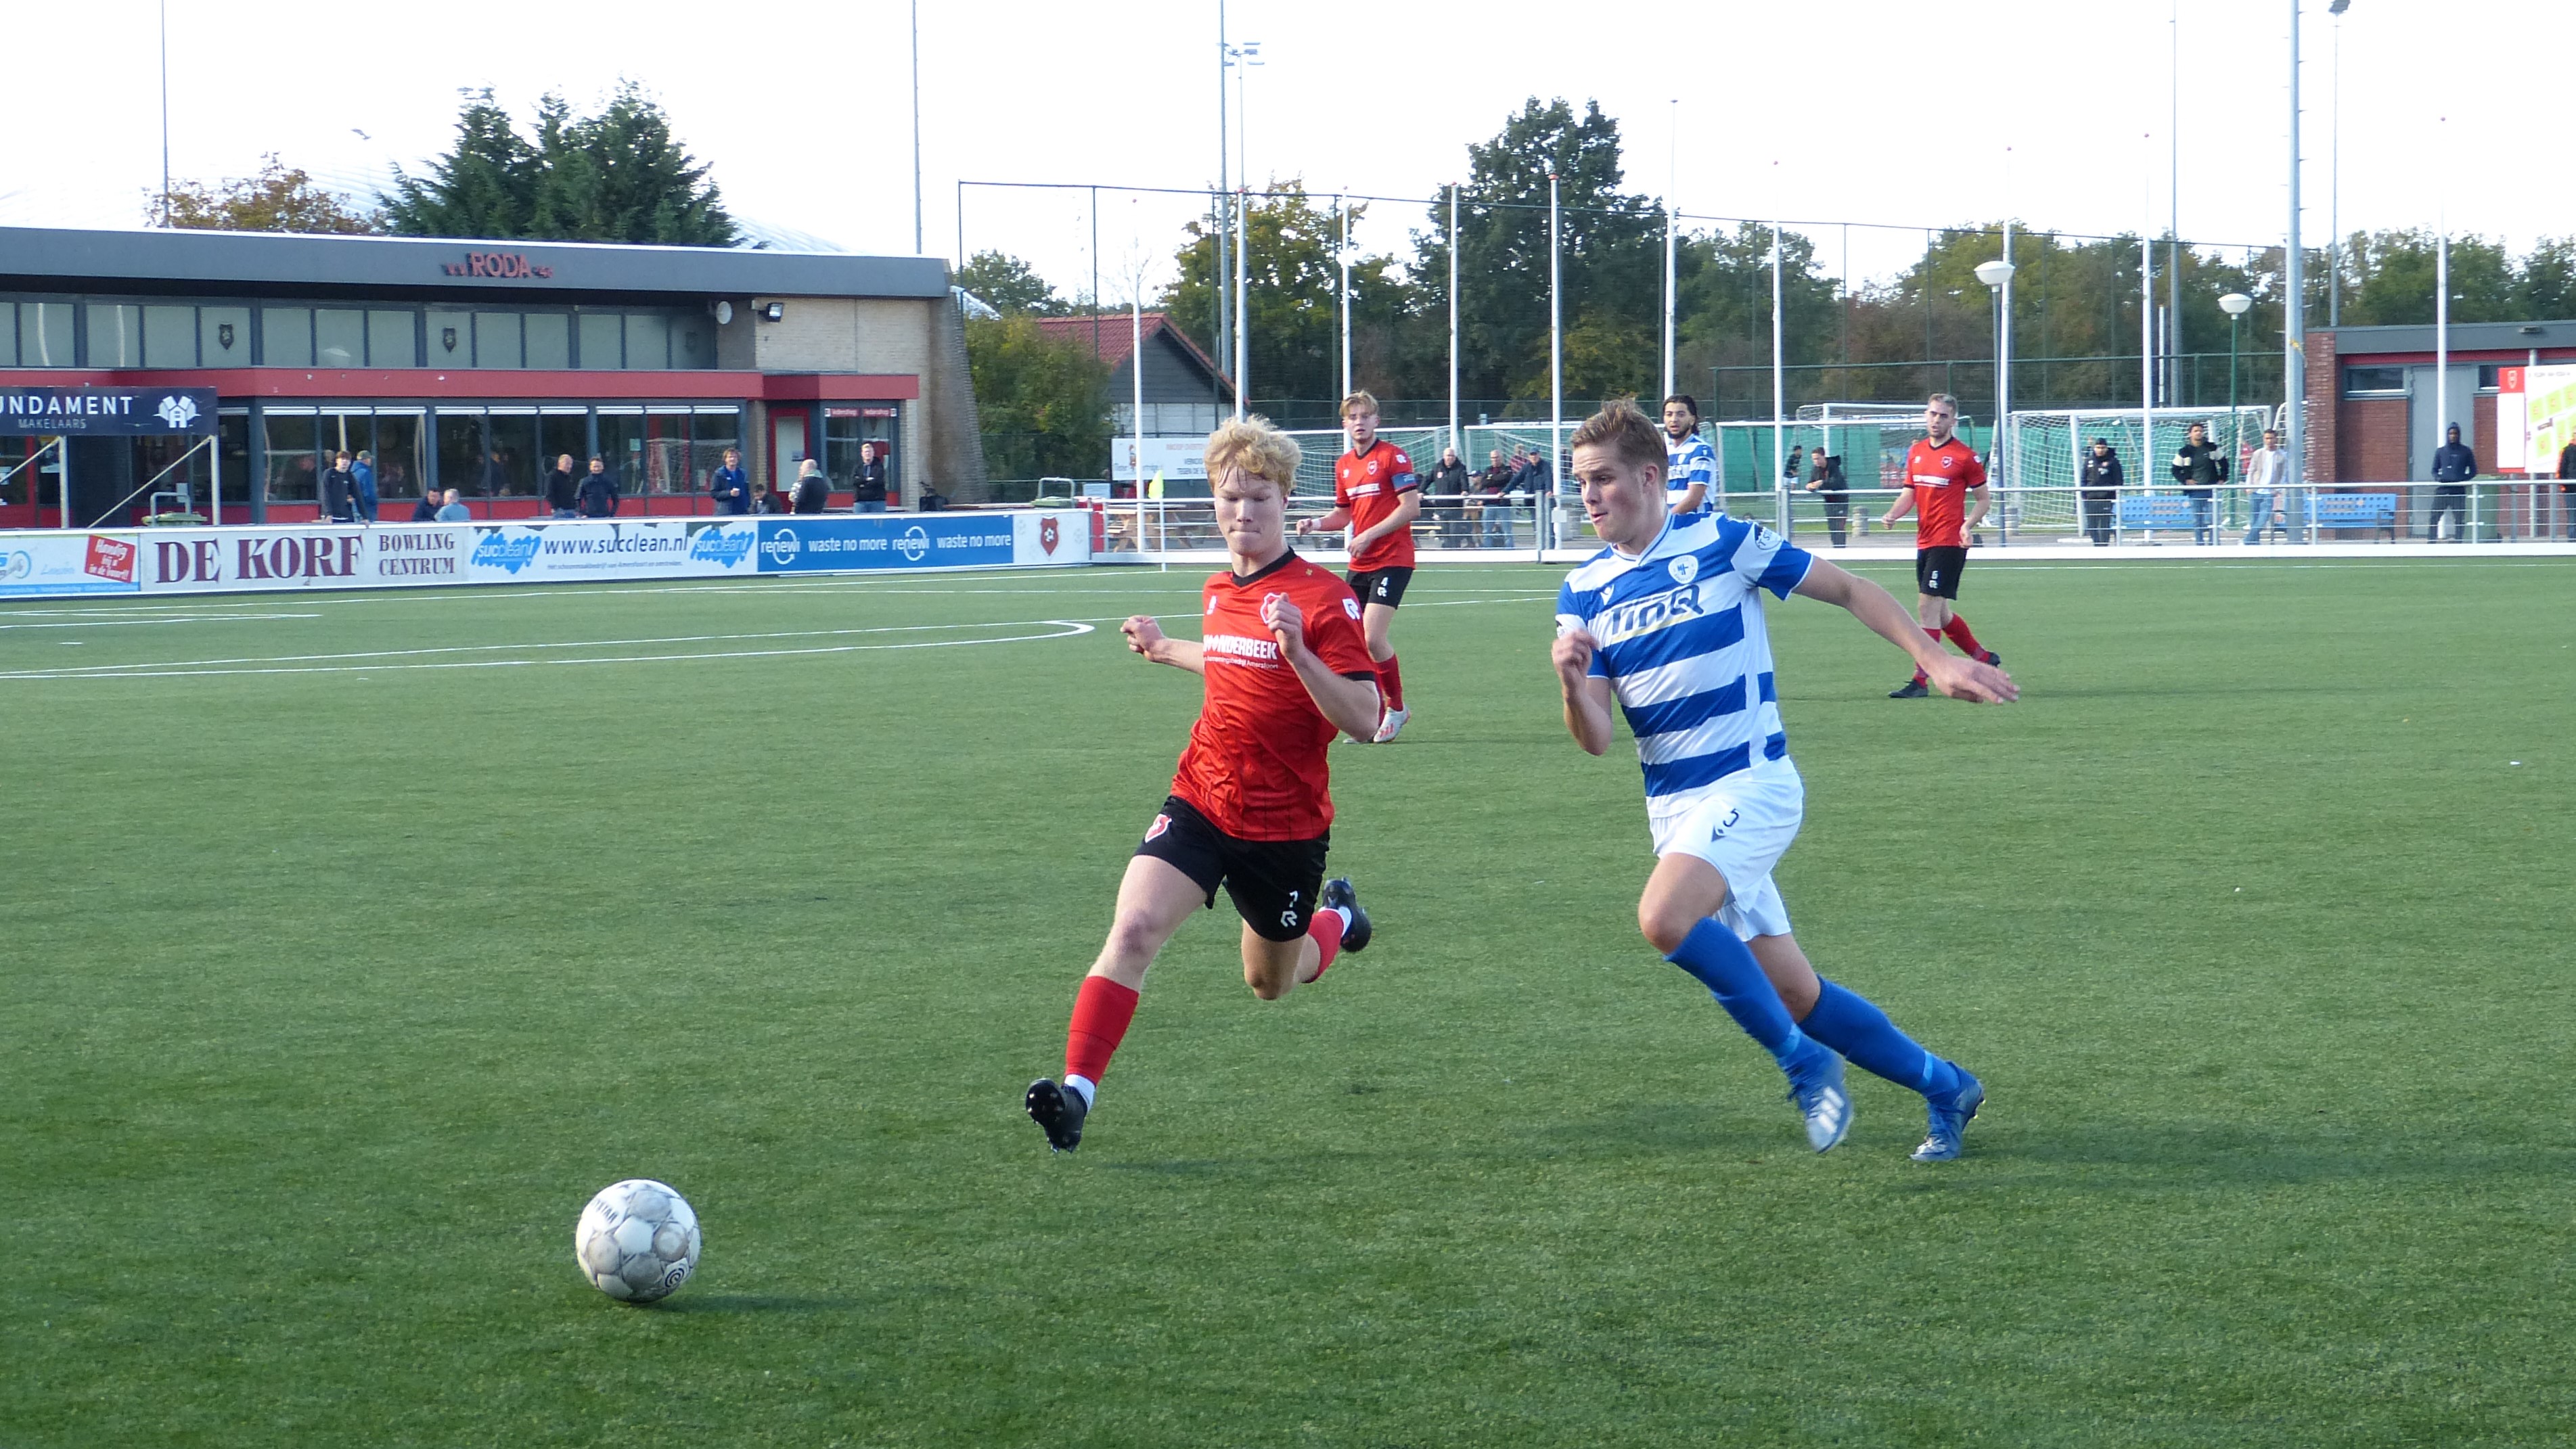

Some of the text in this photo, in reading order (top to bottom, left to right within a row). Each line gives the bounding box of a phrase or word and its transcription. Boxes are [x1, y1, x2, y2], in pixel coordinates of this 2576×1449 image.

[470, 251, 533, 278] RODA
[0, 396, 133, 415] NDAMENT
[18, 418, 87, 429] MAKELAARS
[378, 533, 455, 551] BOWLING
[545, 533, 688, 555] www.succlean.nl
[761, 538, 887, 553] renewi waste no more
[892, 534, 1011, 551] renewi waste no more
[154, 534, 363, 584] DE KORF
[378, 557, 455, 576] CENTRUM
[1290, 890, 1298, 907] 7
